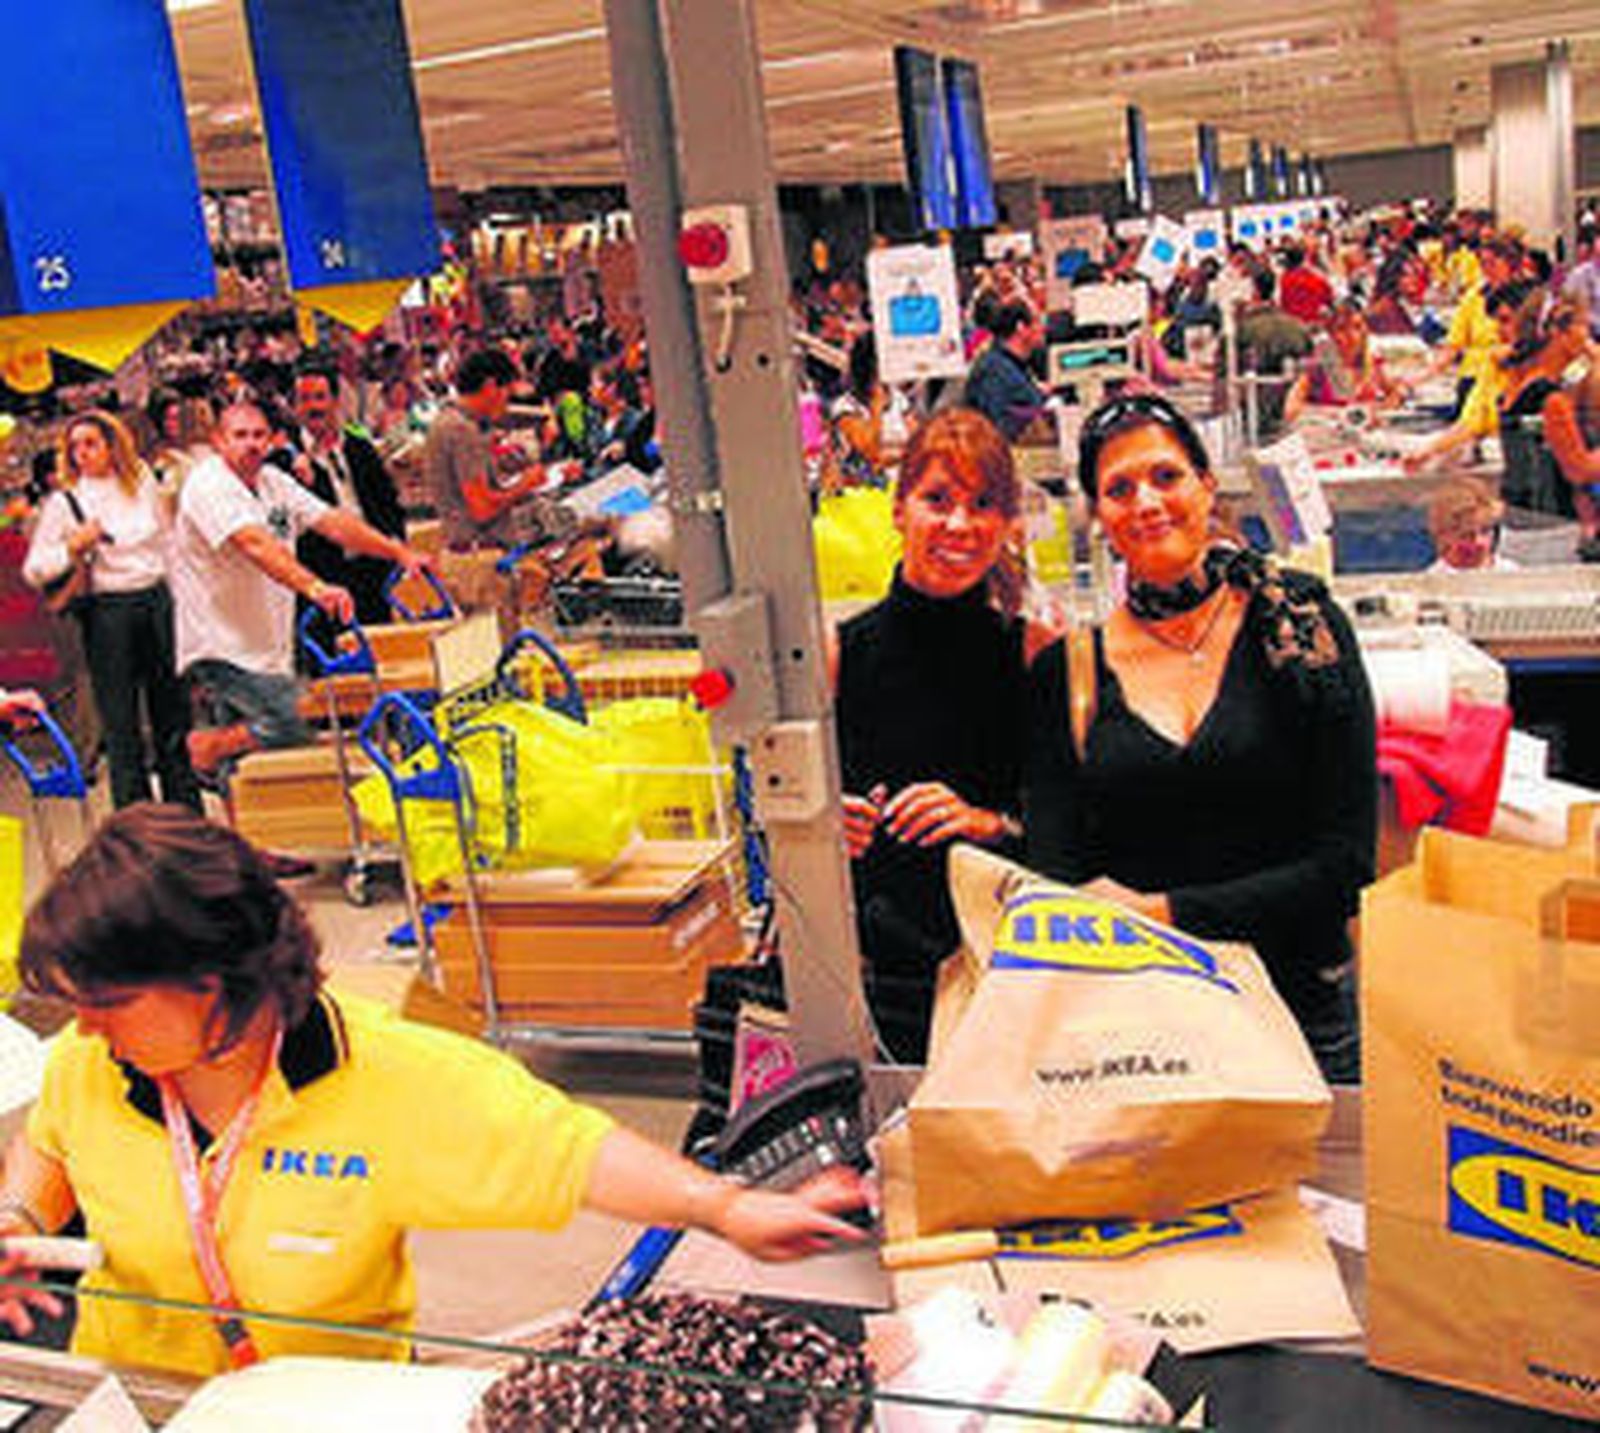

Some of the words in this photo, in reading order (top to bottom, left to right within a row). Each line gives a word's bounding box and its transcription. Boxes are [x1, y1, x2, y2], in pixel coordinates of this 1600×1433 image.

[35, 256, 70, 290] 25
[1437, 1058, 1592, 1118] Bienvenido
[262, 1148, 369, 1179] IKEA
